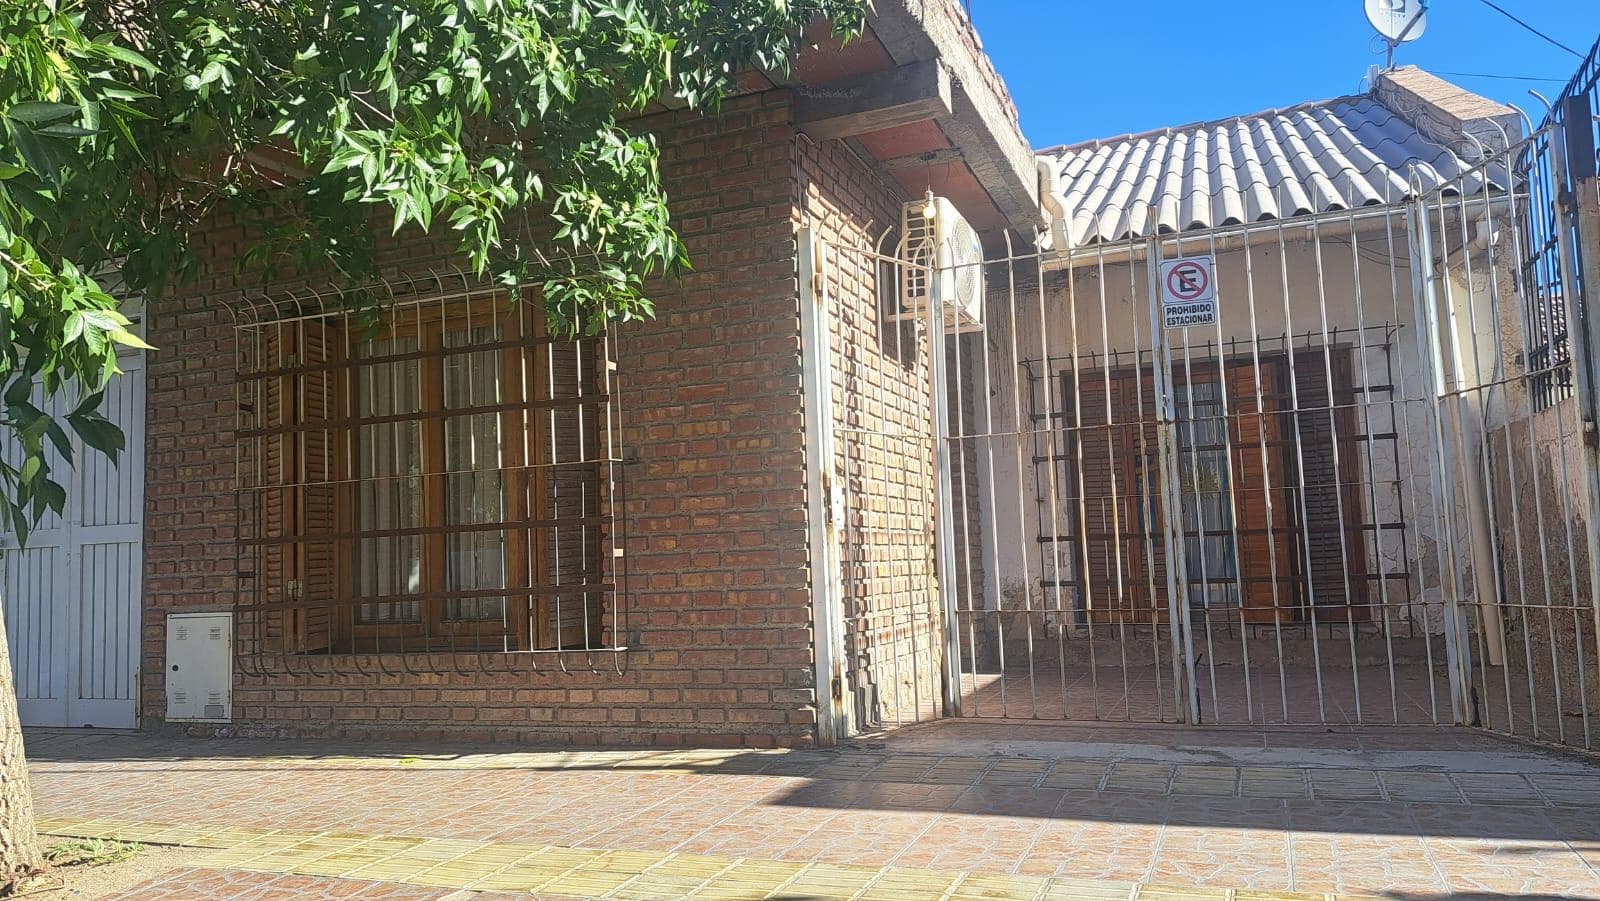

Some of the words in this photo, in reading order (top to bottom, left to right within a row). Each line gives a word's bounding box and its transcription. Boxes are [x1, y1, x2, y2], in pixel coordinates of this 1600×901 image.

[1180, 269, 1197, 292] E
[1166, 304, 1211, 316] PROHIBIDO
[1167, 314, 1213, 326] ESTACIONAR
